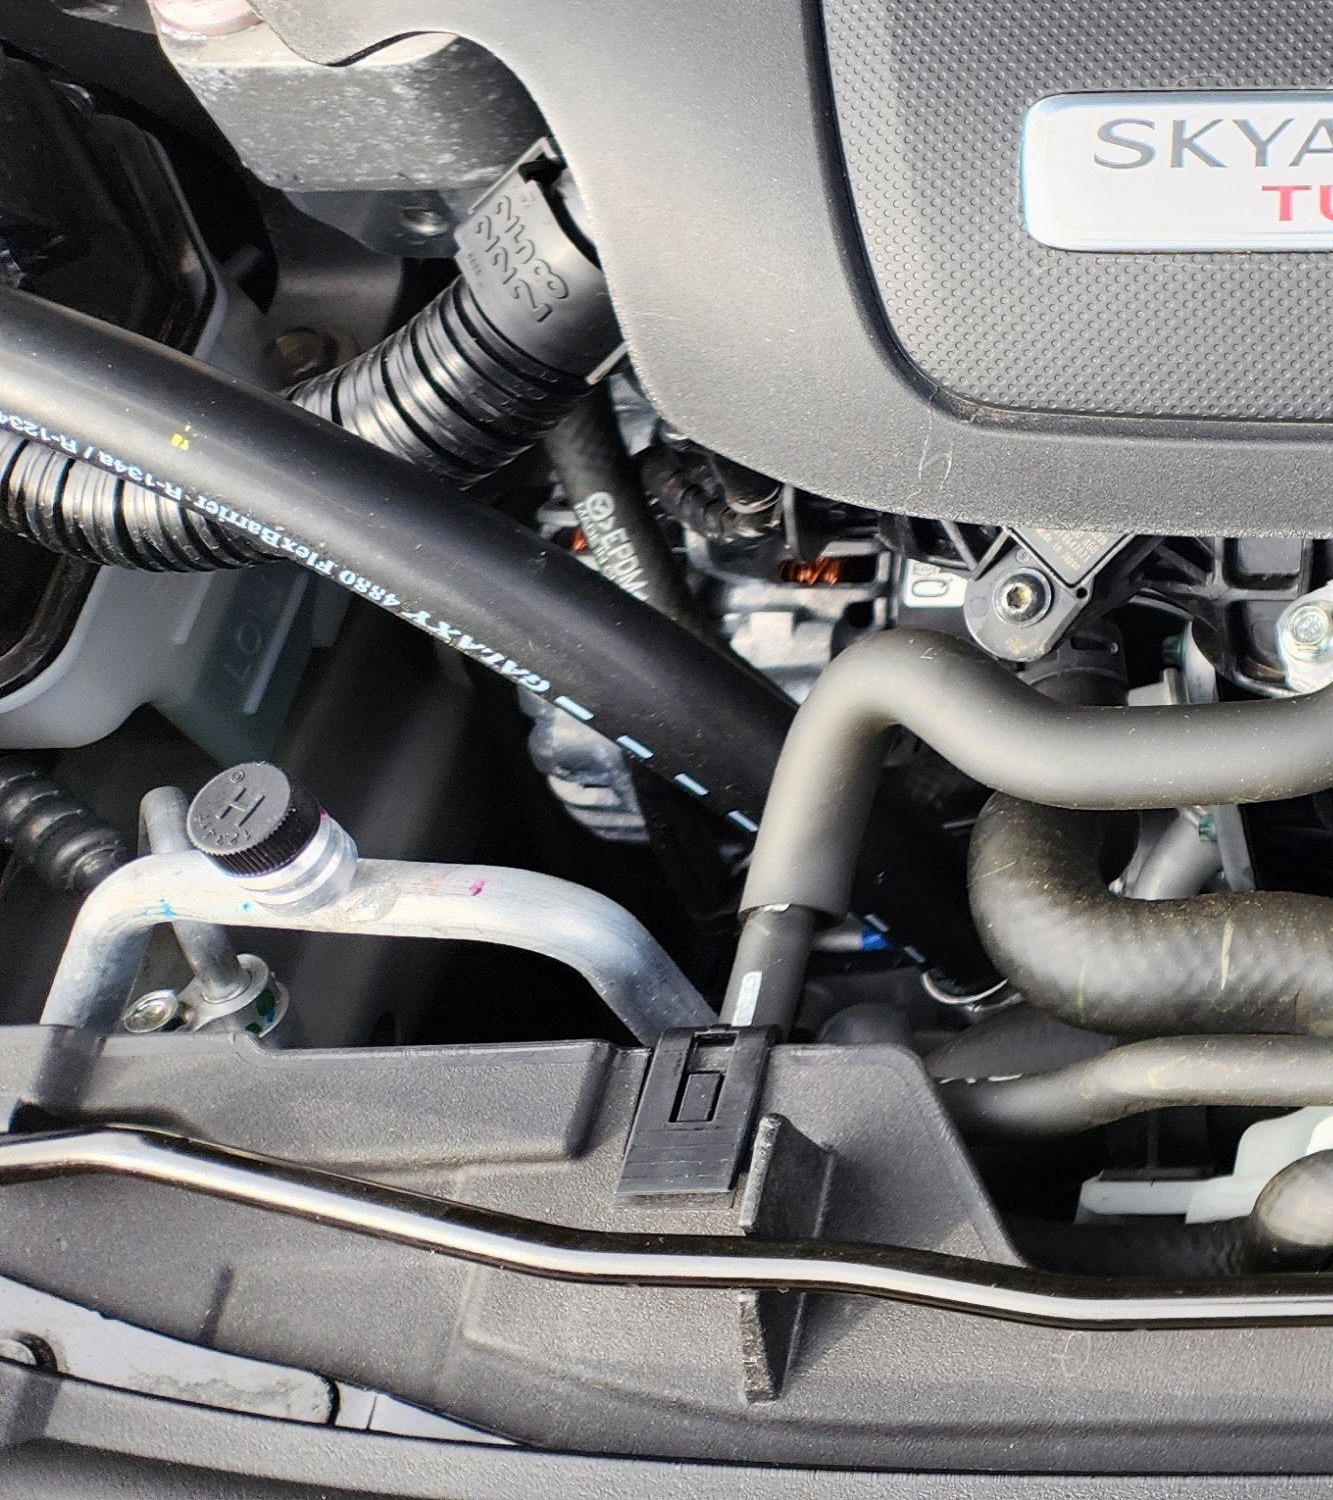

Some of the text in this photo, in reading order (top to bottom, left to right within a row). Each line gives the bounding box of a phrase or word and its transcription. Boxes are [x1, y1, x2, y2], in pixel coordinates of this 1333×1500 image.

[98, 450, 184, 501] R-134a
[193, 494, 337, 576] FlexBarrier
[339, 569, 401, 607] 4880
[401, 609, 551, 693] GALAXY
[215, 784, 266, 828] H
